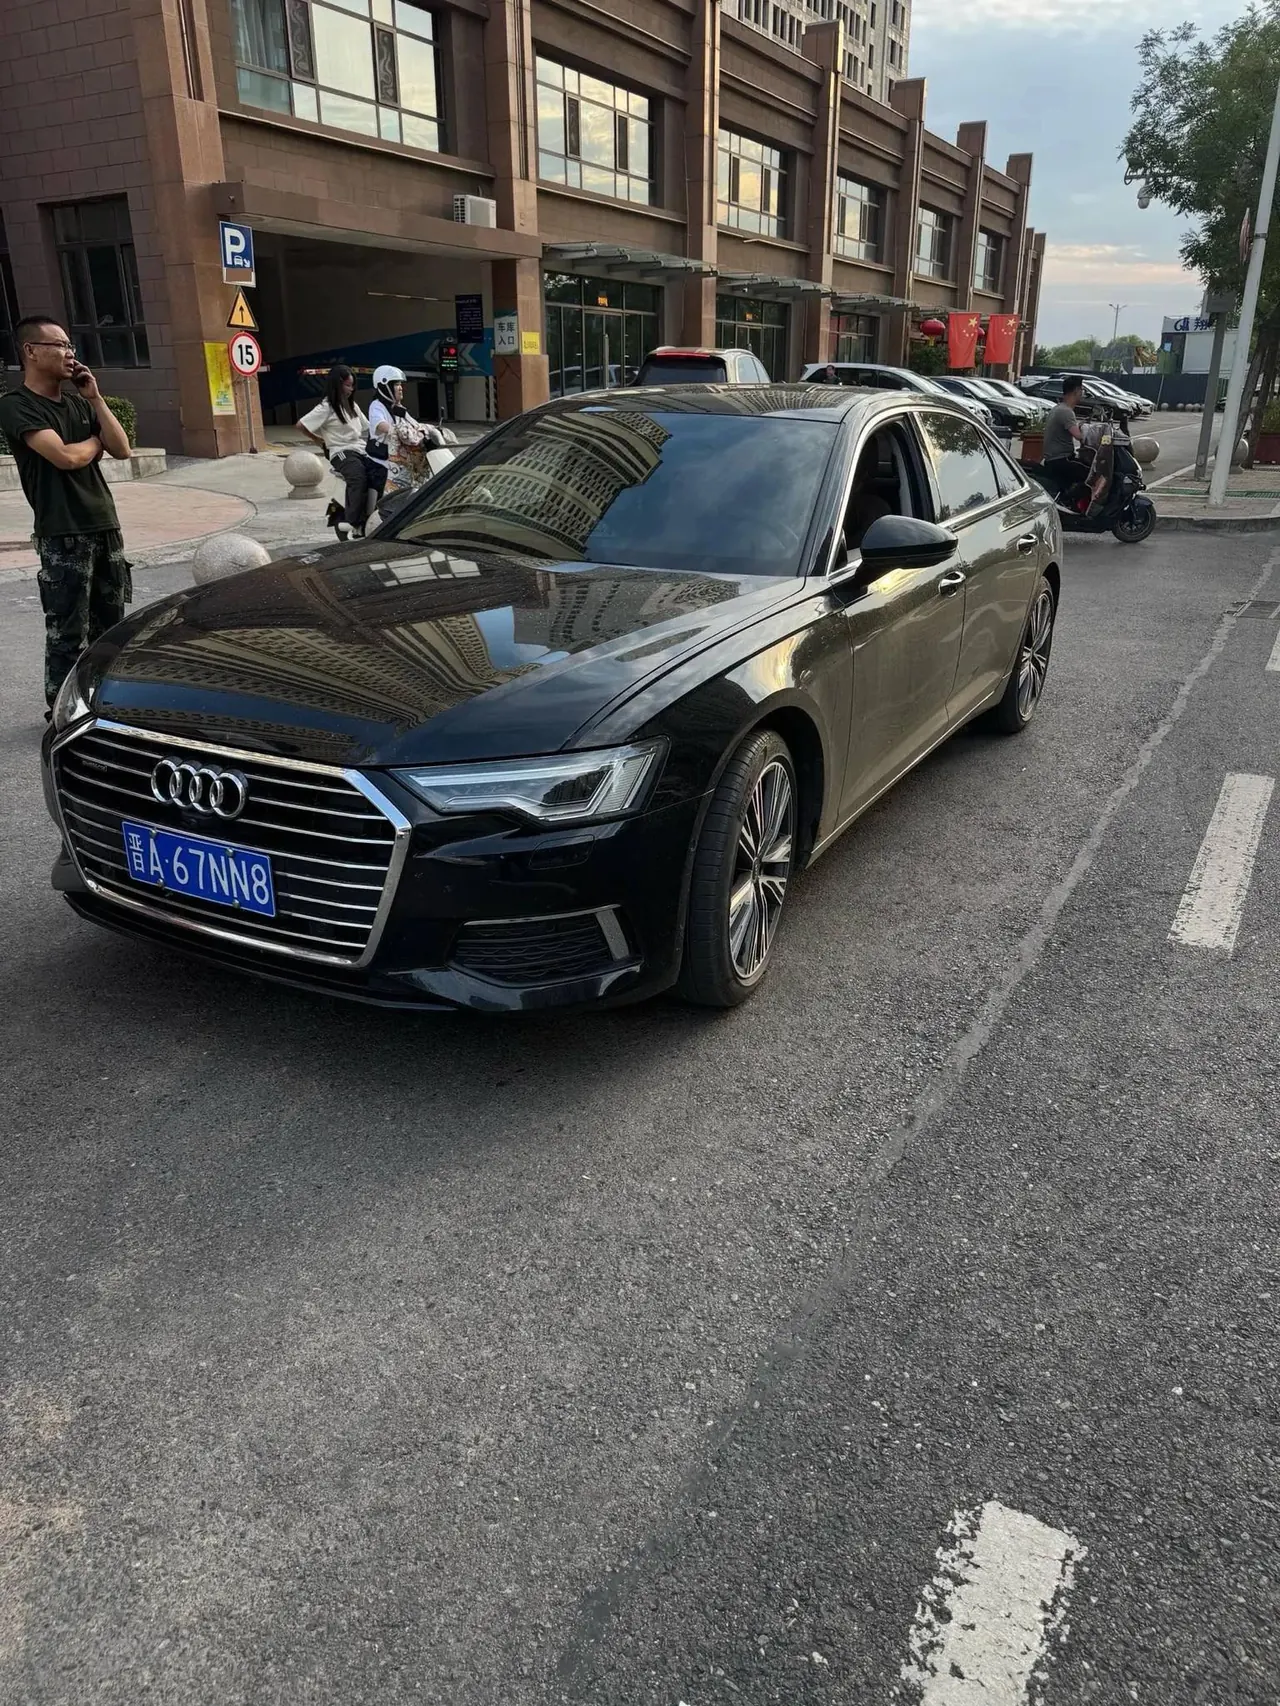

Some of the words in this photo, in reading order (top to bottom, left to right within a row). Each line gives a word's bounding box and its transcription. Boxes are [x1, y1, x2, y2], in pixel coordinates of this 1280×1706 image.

[224, 227, 246, 265] P
[497, 322, 516, 333] 车库
[498, 336, 515, 346] 入口
[237, 344, 255, 366] 15
